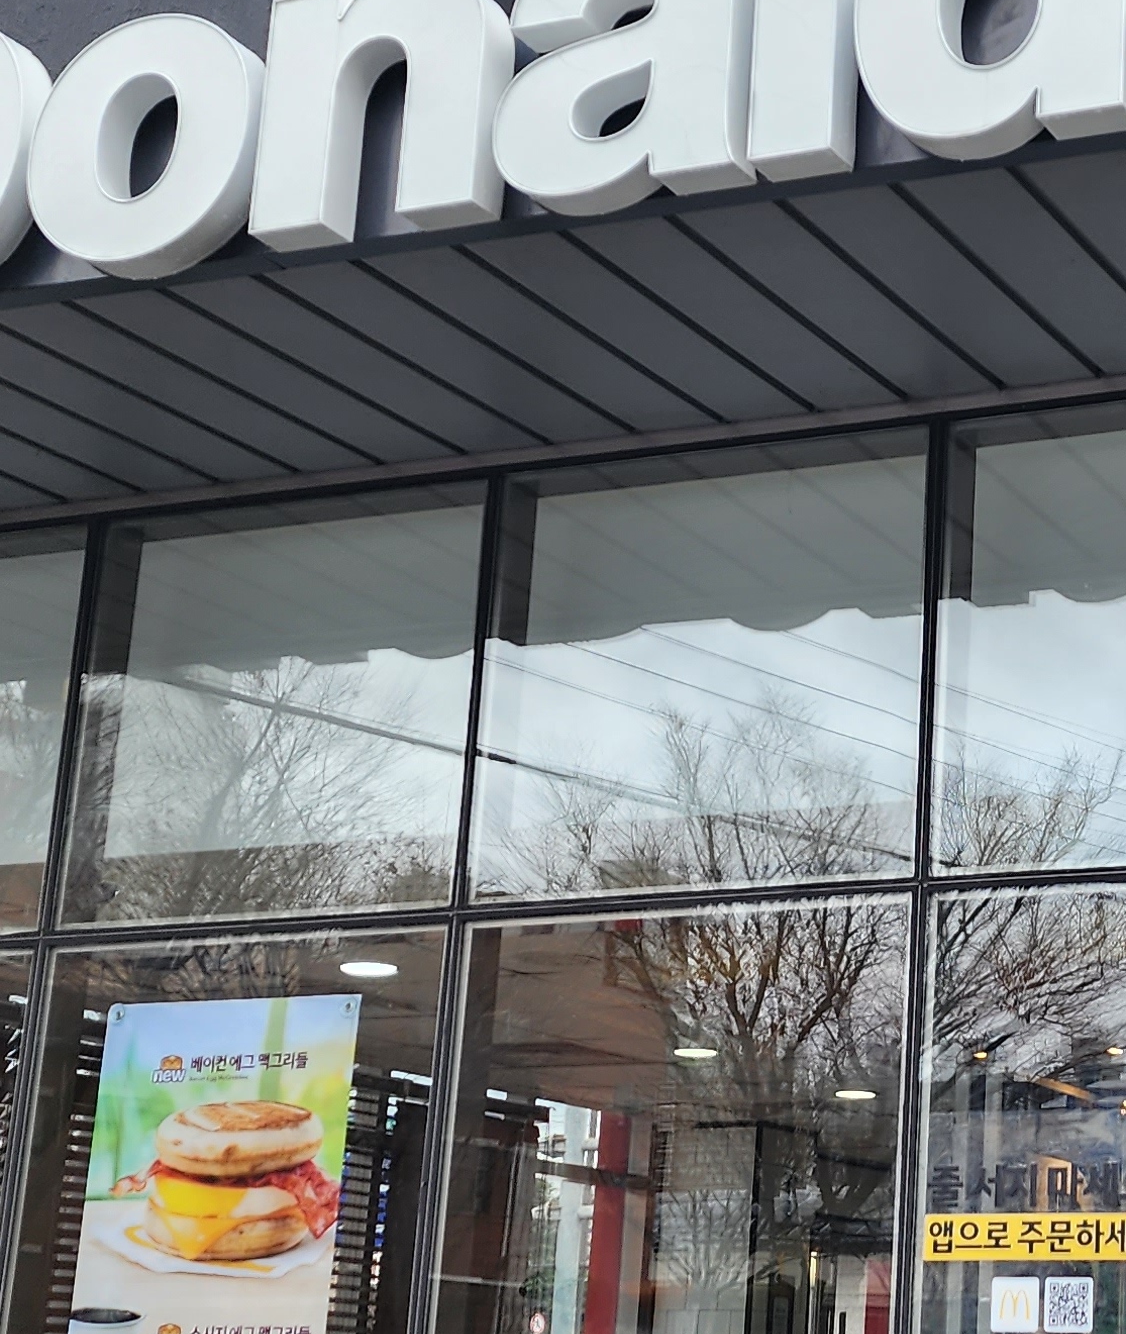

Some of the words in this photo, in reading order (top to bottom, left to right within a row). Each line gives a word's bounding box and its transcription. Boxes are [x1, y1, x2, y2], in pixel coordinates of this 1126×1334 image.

[190, 1054, 228, 1073] 베이컨
[229, 1054, 255, 1072] 에그
[258, 1051, 309, 1071] 맥그리들
[152, 1067, 187, 1084] new
[929, 1220, 1012, 1254] 앱으로
